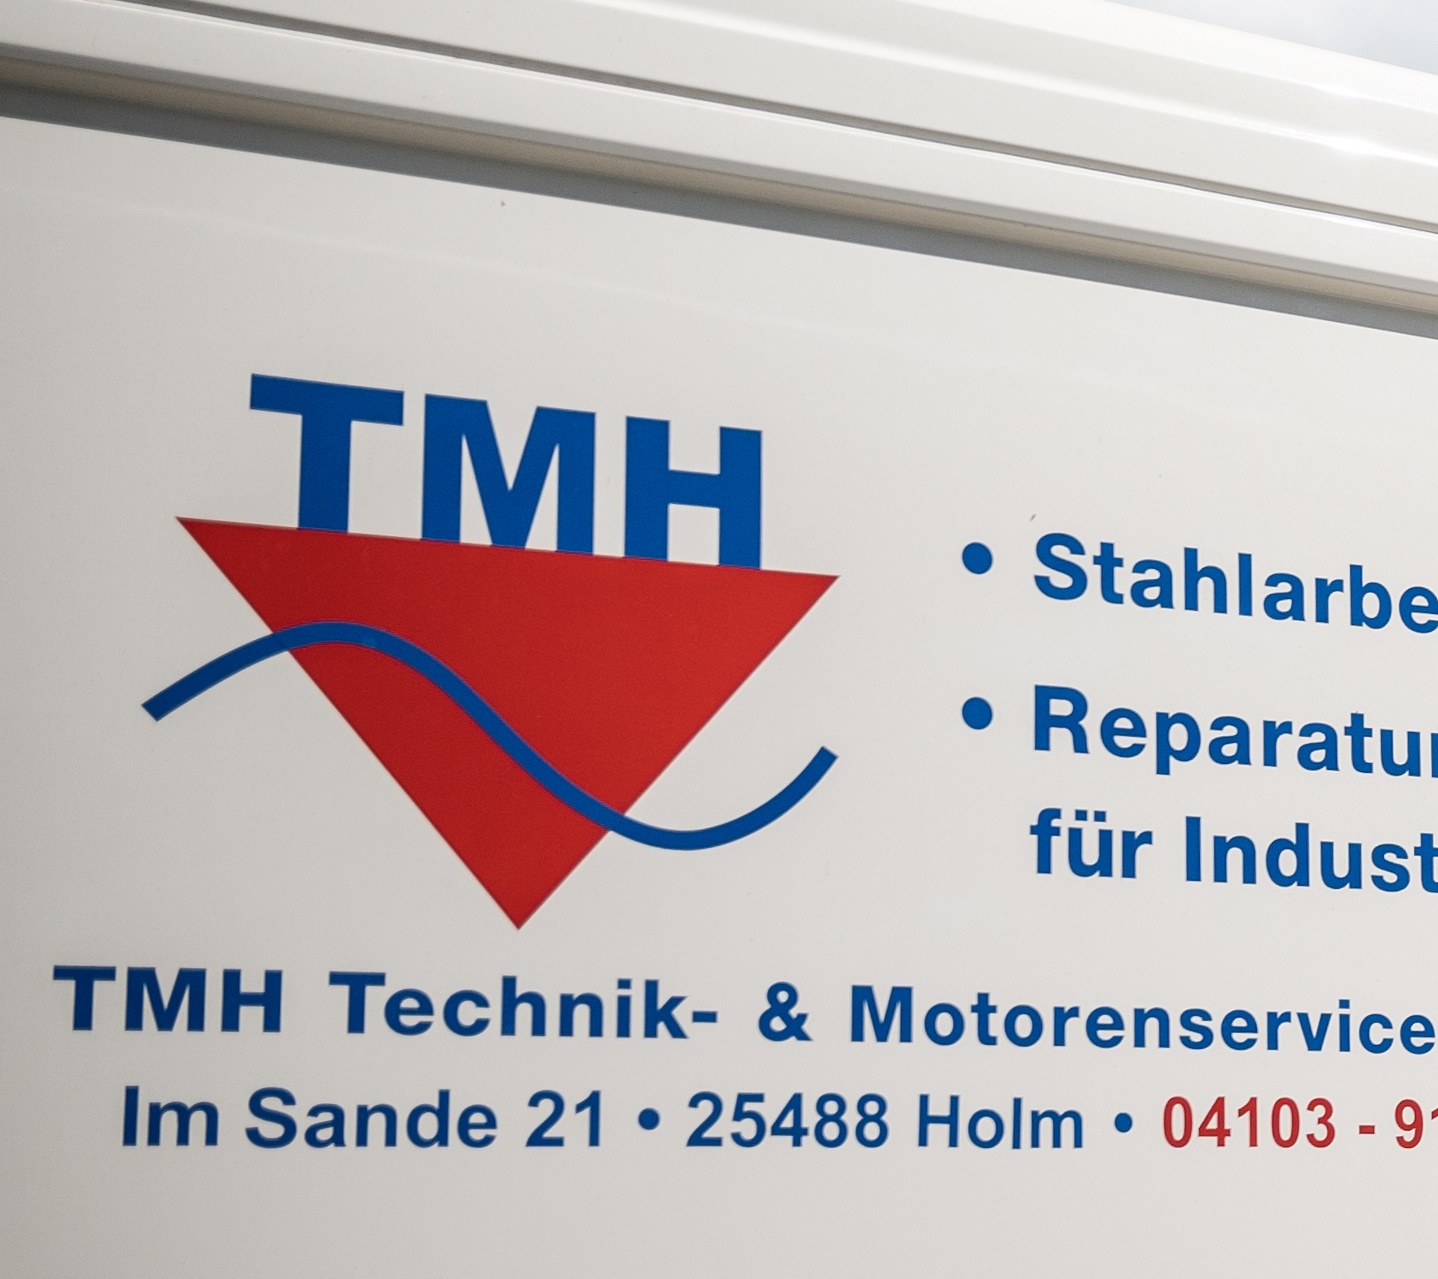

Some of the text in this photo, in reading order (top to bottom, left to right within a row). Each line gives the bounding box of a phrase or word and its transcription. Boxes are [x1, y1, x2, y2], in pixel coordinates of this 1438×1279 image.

[249, 373, 764, 570] TMH
[1028, 806, 1154, 880] für
[53, 966, 284, 1033] TMH
[328, 971, 719, 1040] Technik-
[757, 981, 812, 1043] &
[849, 983, 1437, 1057] Motorenservice
[123, 1086, 220, 1146] Im
[246, 1086, 498, 1150] Sande
[525, 1089, 602, 1149] 21
[686, 1090, 890, 1150] 25488
[916, 1092, 1084, 1151] Holm
[1161, 1094, 1337, 1150] 04103
